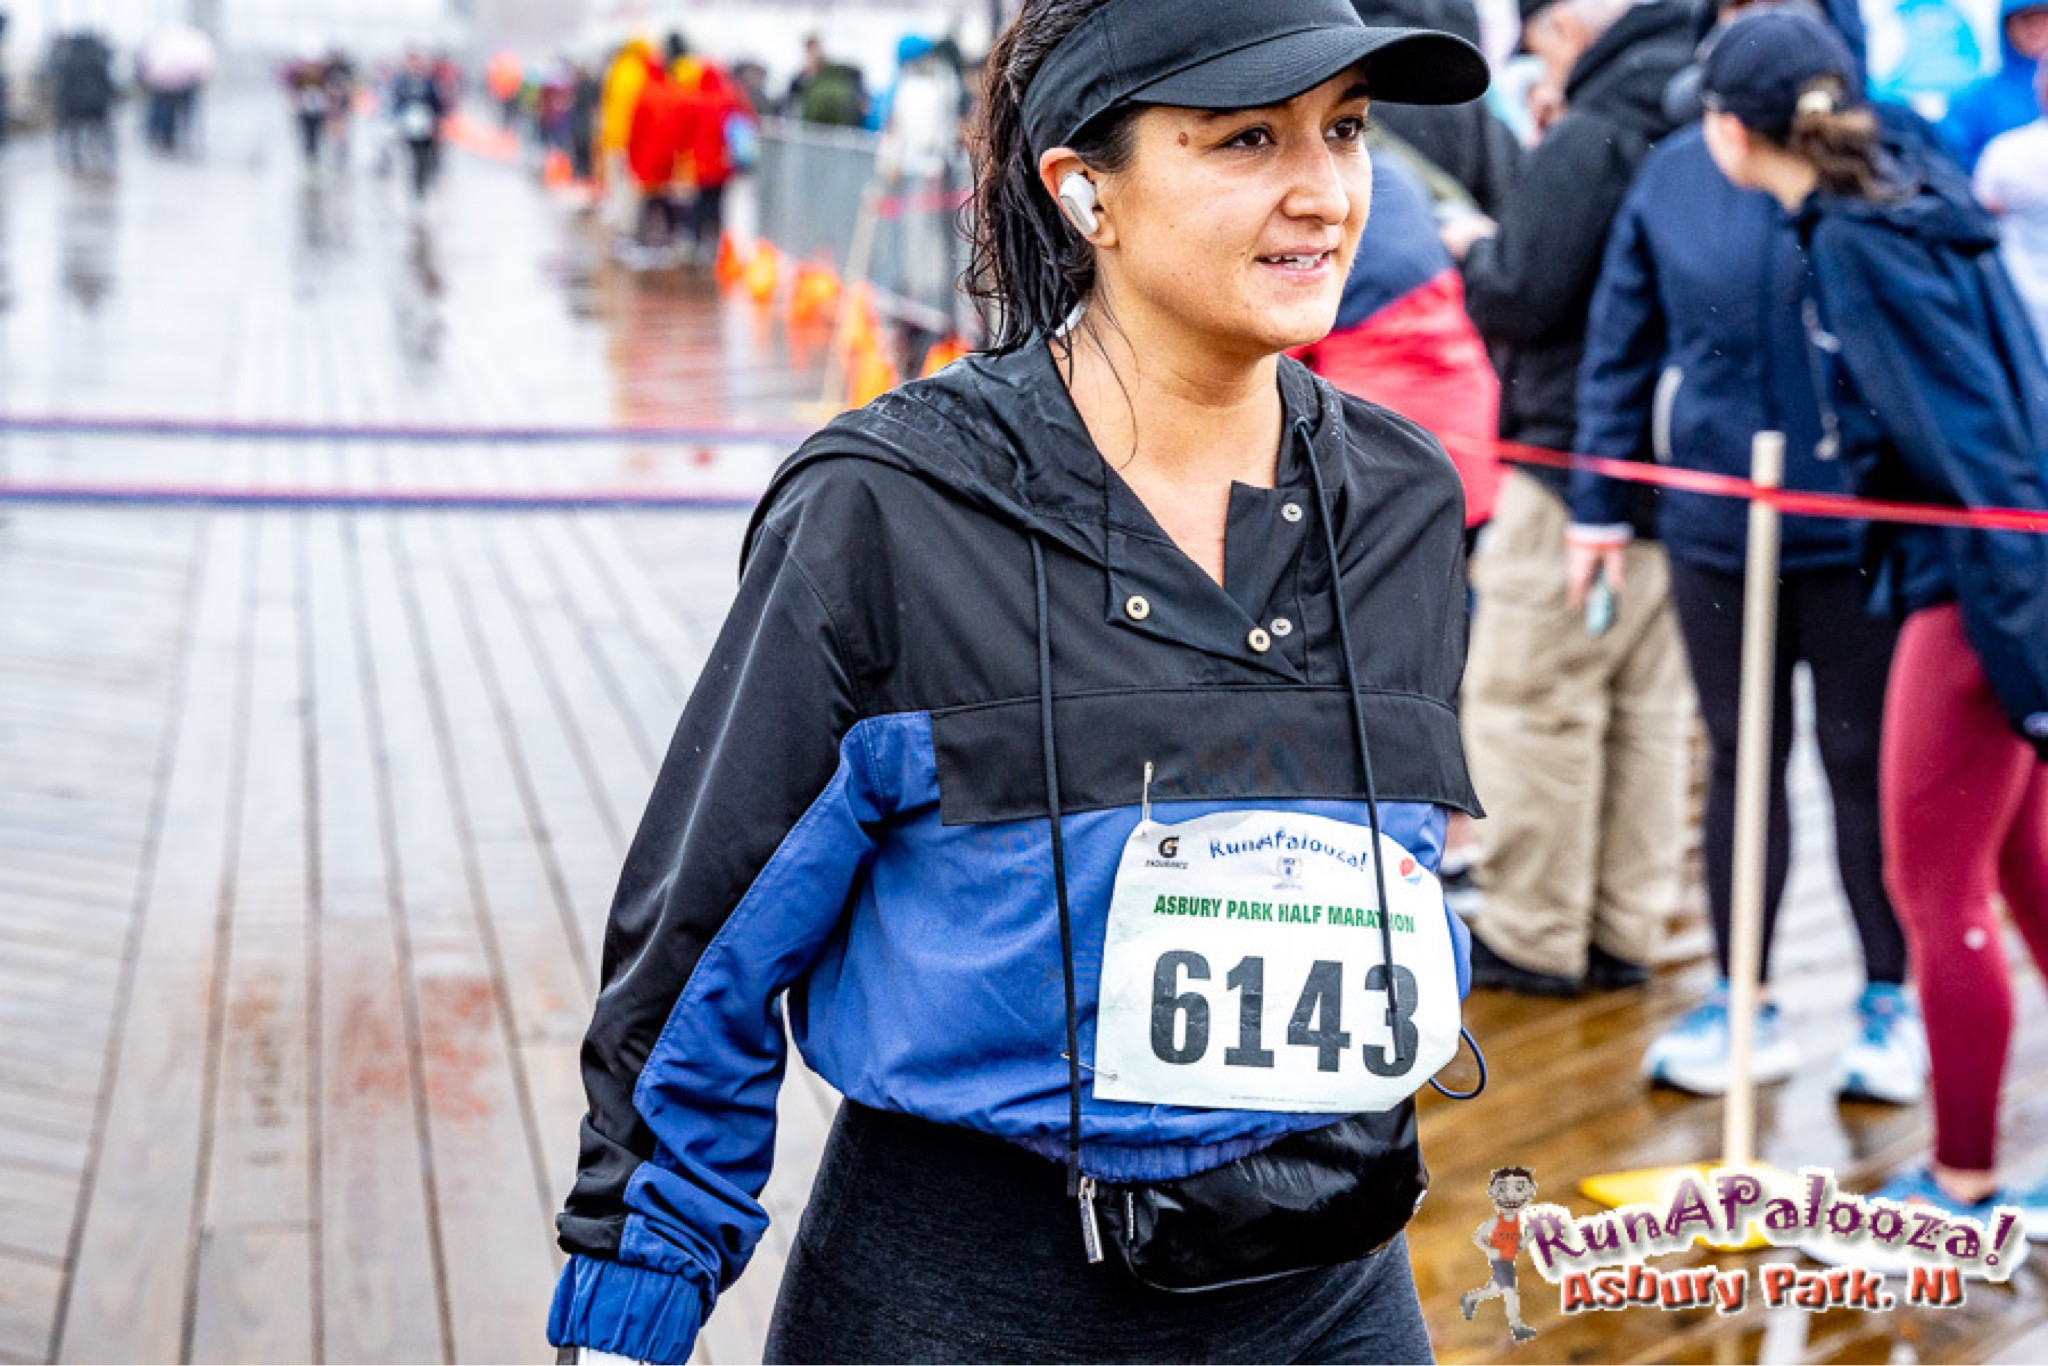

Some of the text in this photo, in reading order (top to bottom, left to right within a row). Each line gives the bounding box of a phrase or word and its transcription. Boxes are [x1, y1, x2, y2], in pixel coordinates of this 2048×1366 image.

[1153, 894, 1222, 918] ASBURY
[1226, 899, 1273, 922] PARK
[1278, 903, 1322, 924] HALF
[1150, 949, 1419, 1077] 6143
